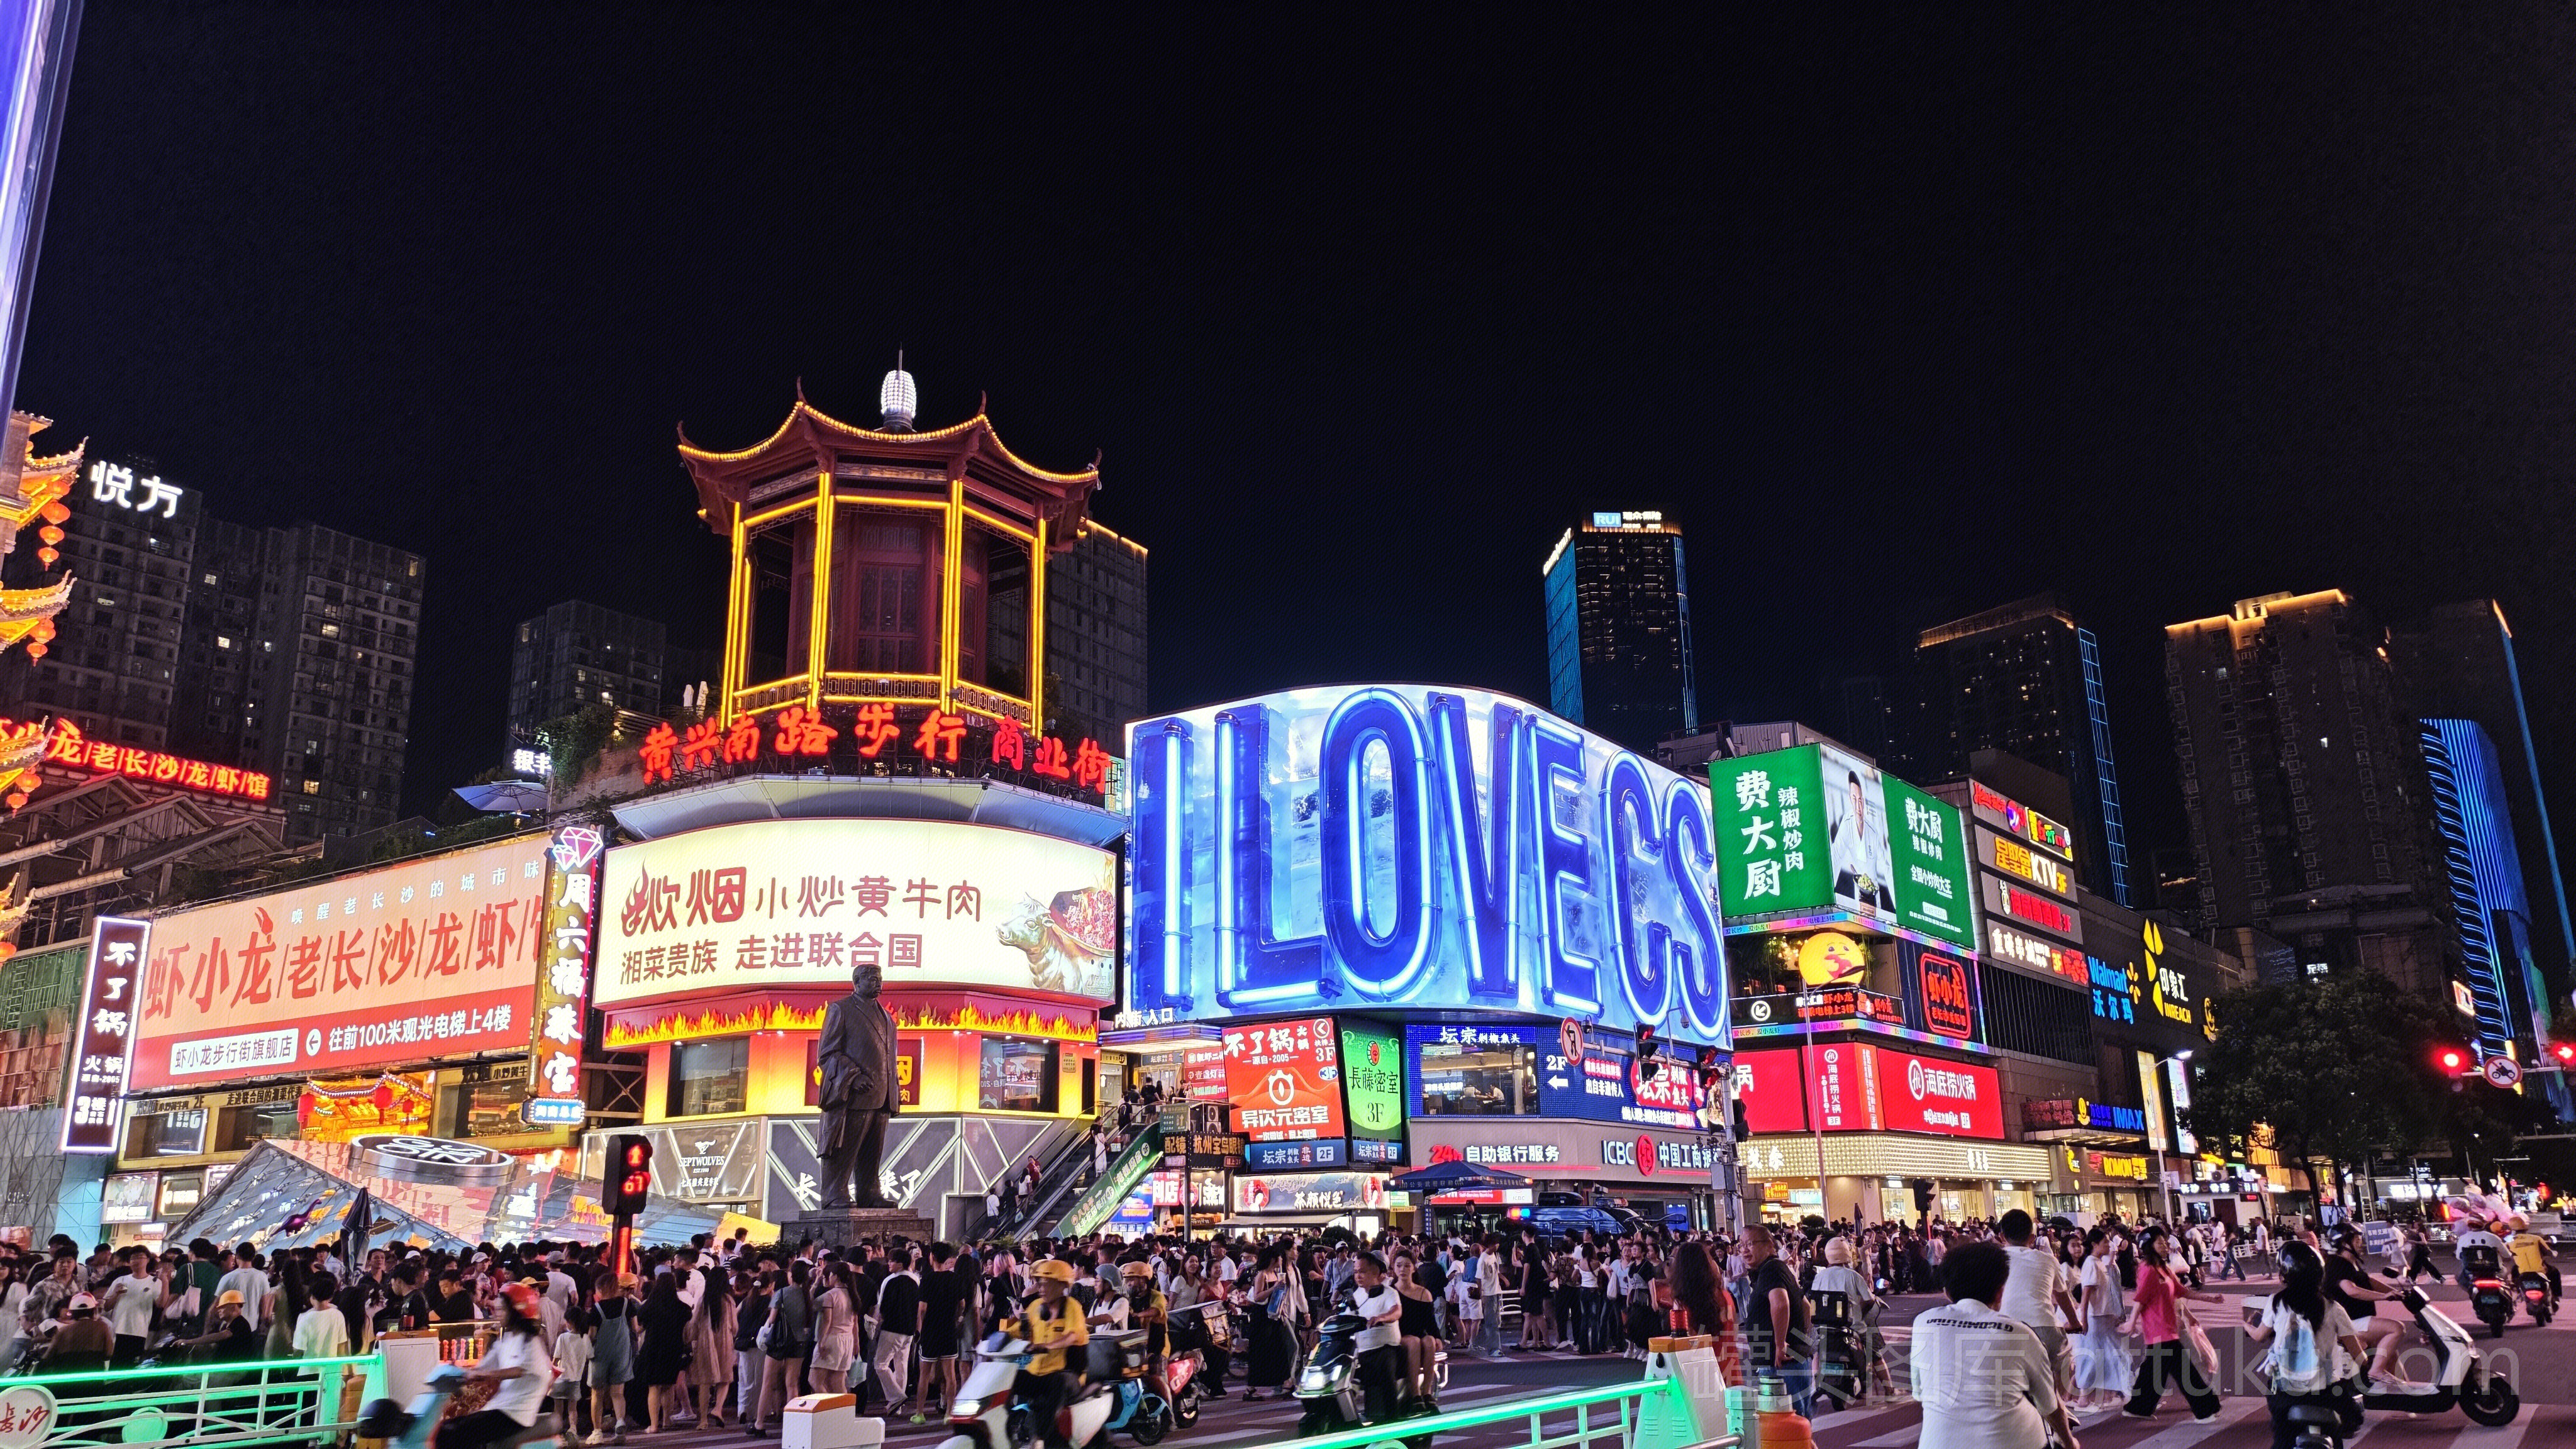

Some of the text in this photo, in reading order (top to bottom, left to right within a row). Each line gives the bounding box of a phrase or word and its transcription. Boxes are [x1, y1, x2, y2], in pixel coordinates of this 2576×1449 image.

[90, 460, 182, 518] 悦方
[1596, 515, 1620, 525] RUI
[639, 701, 1111, 794] 黄兴南路步行商业街
[1777, 786, 1804, 872] 辣椒炒肉
[1905, 797, 1942, 843] 费大厨
[1735, 770, 1782, 900] 费大厨
[1912, 834, 1943, 861] 辣椒炒肉
[1911, 864, 1953, 895] 全国小炒肉大王
[2031, 852, 2058, 891] KTV
[2057, 871, 2067, 894] 3F
[291, 860, 540, 924] 唤醒老长沙的城市味
[620, 855, 981, 936] 炊烟 小炒黄牛肉
[619, 932, 923, 985] 湘菜贵族 走进联合国
[543, 873, 590, 1094] 周六福珠宝
[2087, 955, 2129, 994] Walmart
[2159, 967, 2189, 1002] 印象汇
[92, 942, 136, 1036] 不了锅
[1927, 967, 1965, 1009] 虾小龙
[1115, 1008, 1174, 1028] 内街入口
[2092, 988, 2134, 1024] 沃尔玛
[2164, 1001, 2192, 1024] INREACH
[328, 1004, 513, 1052] 往前100米观光电梯上4楼
[1296, 1025, 1309, 1050] 火锅
[1440, 1026, 1477, 1044] 坛宗
[174, 1036, 293, 1069] 虾小龙步行街旗舰店
[1224, 1028, 1295, 1058] 不了锅
[1316, 1047, 1335, 1062] 3F
[83, 1055, 123, 1074] 火锅
[1321, 1067, 1338, 1079] 3F
[1546, 1055, 1568, 1070] 2F
[1349, 1066, 1398, 1094] 長藤密室
[1924, 1068, 1976, 1101] 海底捞火锅
[1241, 1105, 1330, 1128] 异次元密室
[1367, 1102, 1384, 1123] 3F
[2113, 1106, 2145, 1131] IMAX
[1142, 1144, 1150, 1155] 2F
[1164, 1135, 1187, 1154] 配镜
[1192, 1134, 1245, 1155] 杭州宝岛眼镜
[1262, 1148, 1286, 1165] 坛宗
[1319, 1149, 1333, 1160] 2F
[1389, 1148, 1396, 1157] 2F
[1466, 1144, 1560, 1163] 自助银行服务
[1602, 1140, 1635, 1165] ICBC
[679, 1155, 725, 1167] SEPTWOLVES
[2103, 1157, 2133, 1177] ROMON
[793, 1169, 921, 1202] 长来了
[1294, 1190, 1345, 1209] 茶颜悦色
